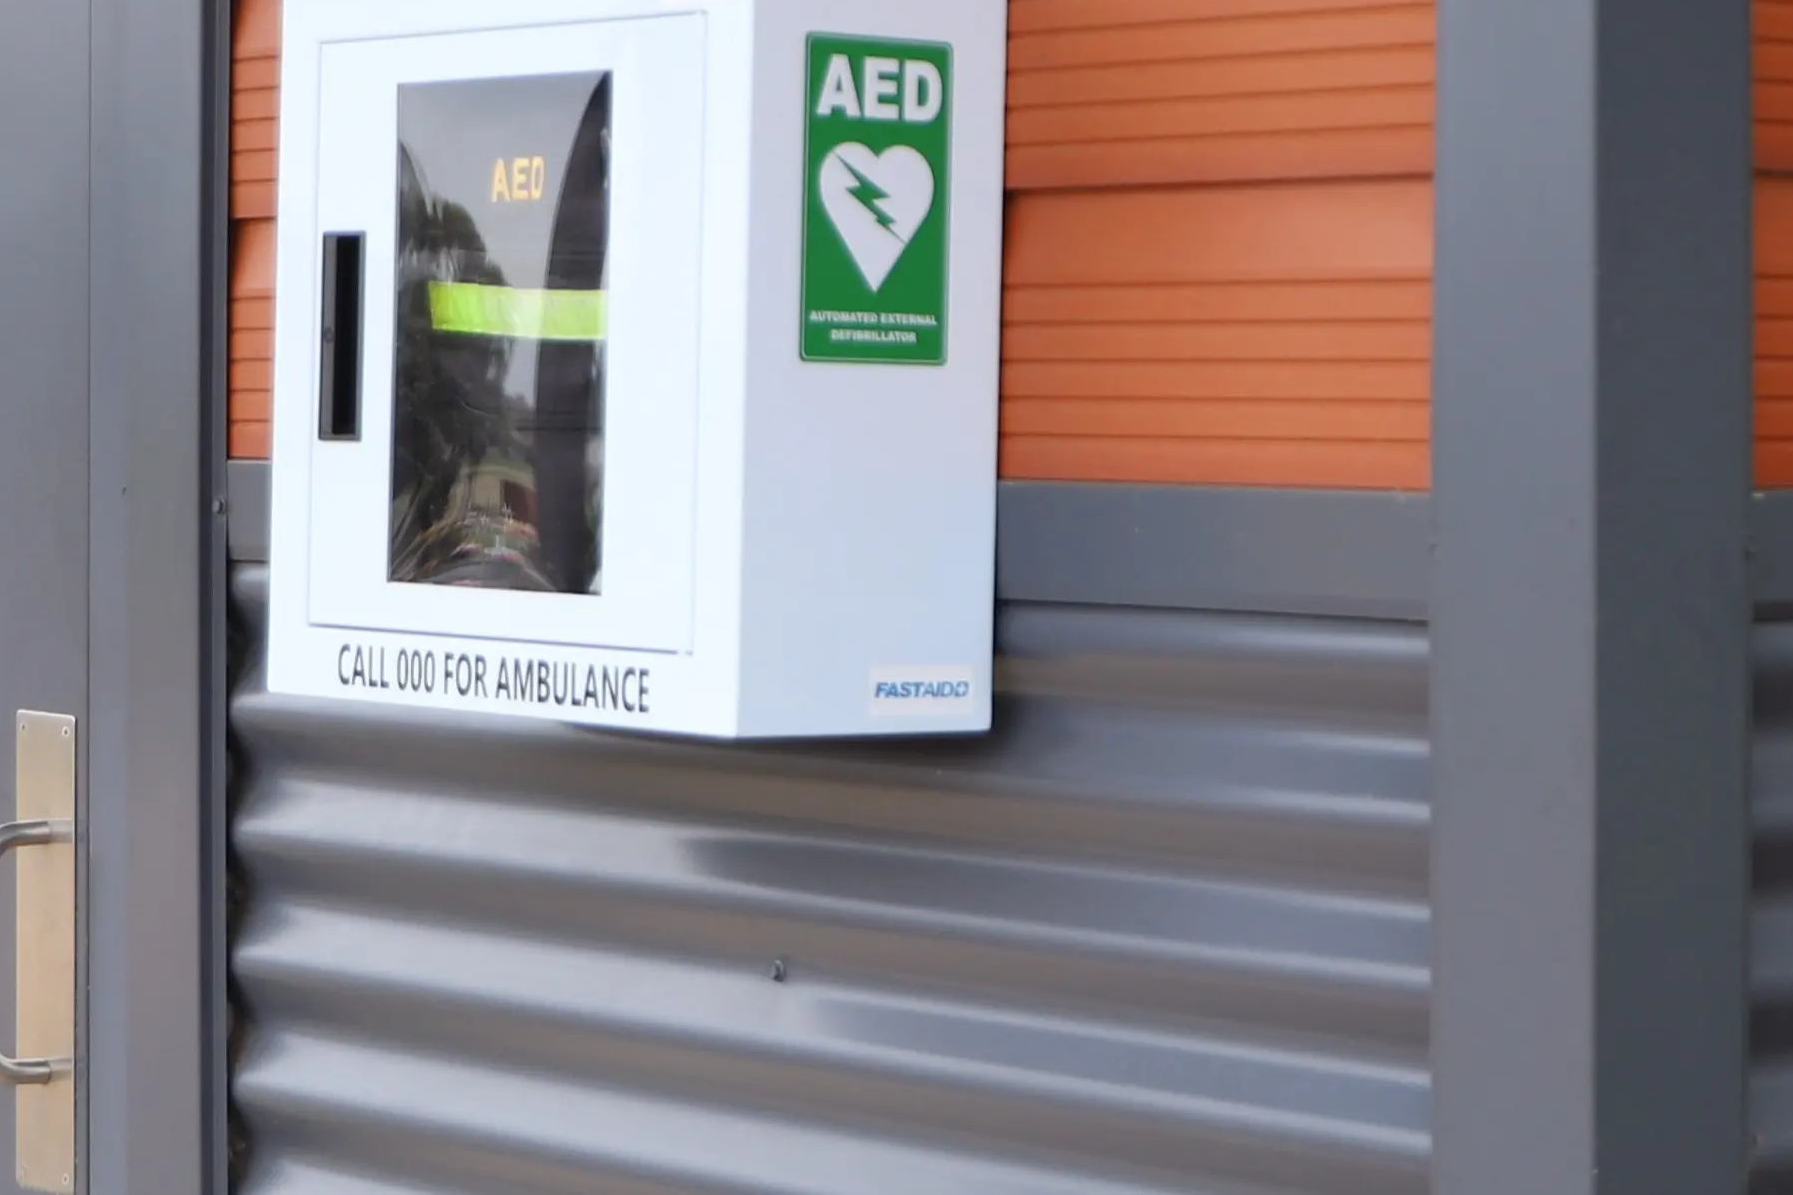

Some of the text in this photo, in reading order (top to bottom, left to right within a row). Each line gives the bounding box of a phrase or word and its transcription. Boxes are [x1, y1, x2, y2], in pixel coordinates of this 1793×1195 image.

[816, 53, 944, 124] AED
[491, 155, 545, 203] AED
[809, 309, 938, 326] AUTOMATED EXTERNAL
[830, 328, 917, 344] DEFIBRILLATOR
[337, 643, 651, 714] CALL 000 FOR AMBULANCE
